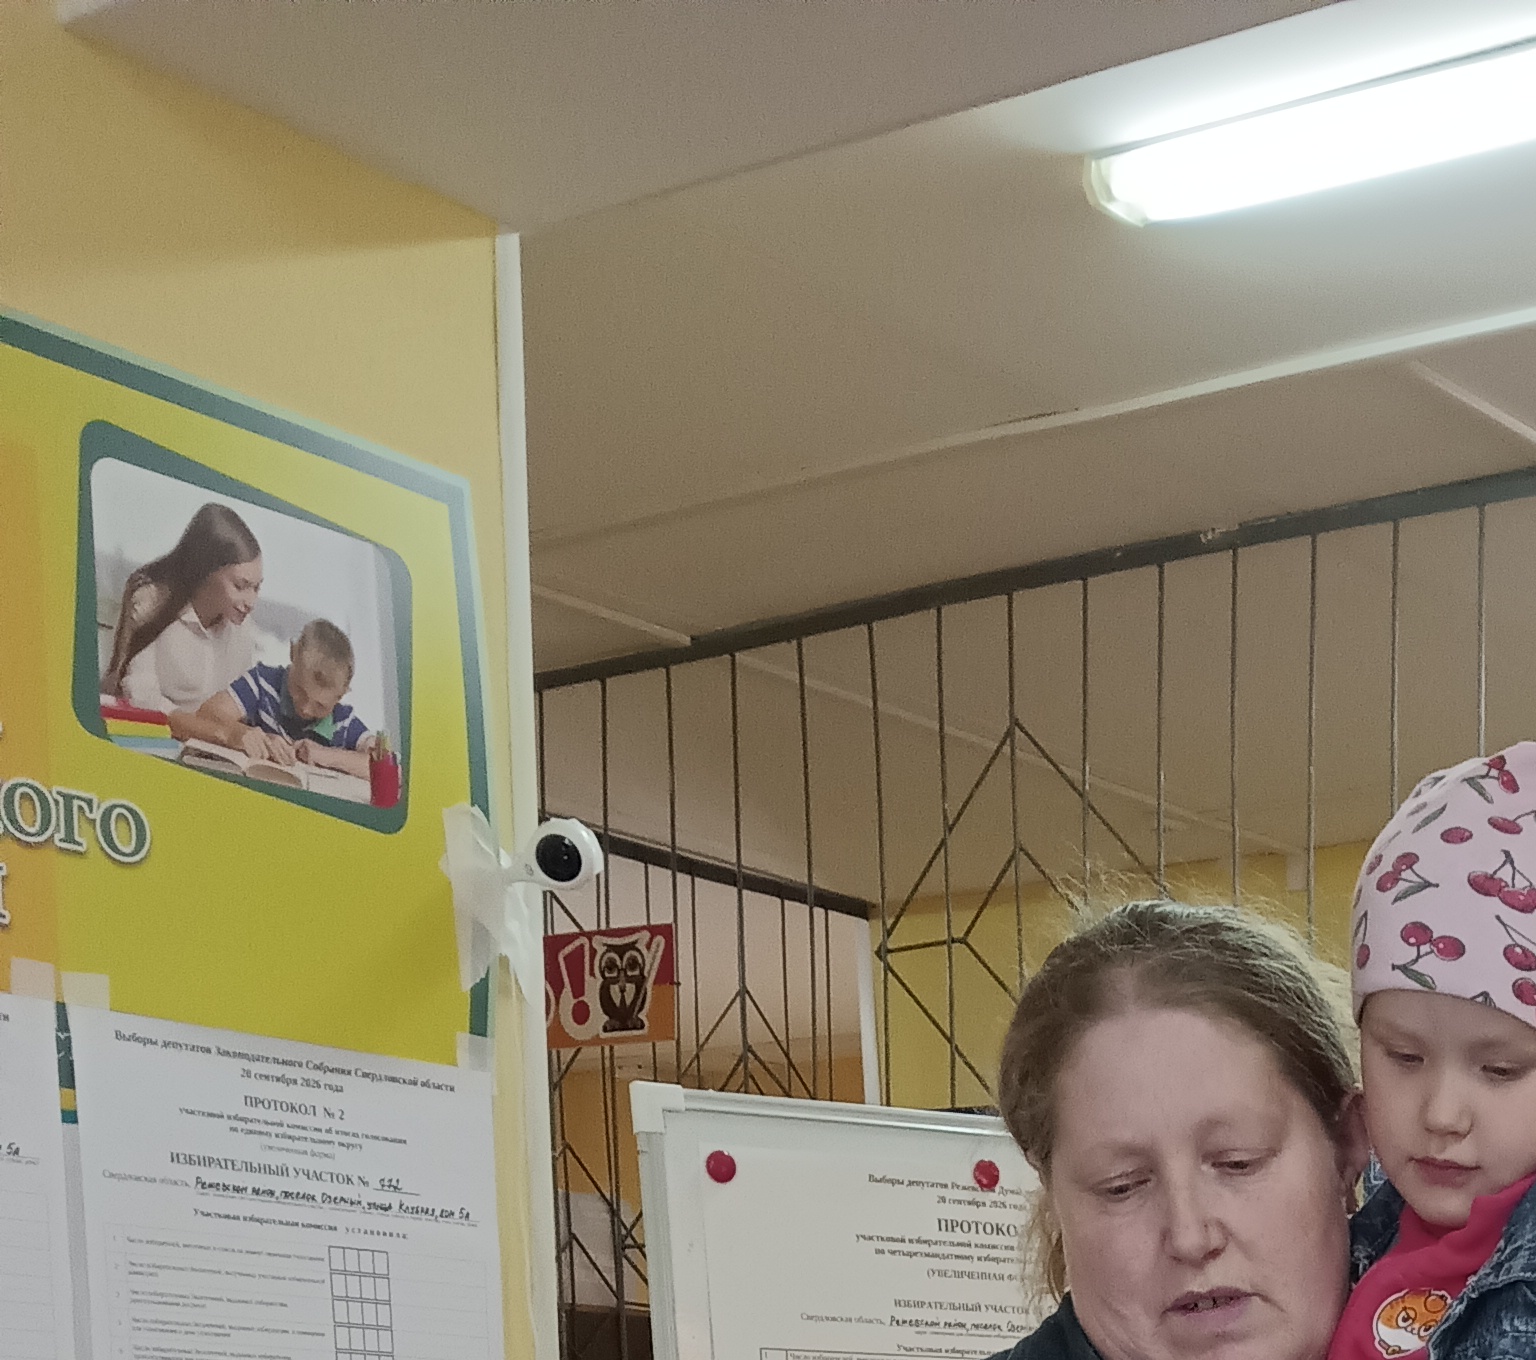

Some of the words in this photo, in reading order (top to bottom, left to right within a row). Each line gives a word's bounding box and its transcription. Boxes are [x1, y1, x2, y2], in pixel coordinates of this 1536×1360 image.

[0, 778, 150, 864] ого
[114, 1029, 159, 1046] Выборы
[161, 1039, 212, 1055] депутатов
[215, 1045, 303, 1069] Законодательного
[305, 1060, 352, 1076] Собрания
[354, 1068, 418, 1086] Свердловской
[420, 1079, 455, 1093] области
[240, 1068, 251, 1079] 20
[254, 1071, 298, 1087] сентября
[300, 1077, 321, 1090] 2026
[324, 1083, 344, 1094] года
[243, 1095, 317, 1117] ПРОТОКОЛ
[323, 1107, 335, 1119] №
[338, 1109, 345, 1121] 2
[169, 1151, 289, 1178] ИЗБИРАТЕЛЬНЫЙ
[293, 1166, 355, 1186] УЧАСТОК
[357, 1175, 370, 1188] №
[868, 1173, 904, 1187] Выборы
[906, 1179, 949, 1190] депутатов
[936, 1195, 946, 1204] 20
[948, 1198, 987, 1209] сентября
[988, 1200, 1007, 1209] 2026
[937, 1217, 1027, 1238] ПРОТОКО
[855, 1233, 906, 1244] участковой
[907, 1236, 972, 1249] избирательной
[887, 1248, 974, 1263] четырехмандатному
[926, 1268, 1004, 1282] (УВЕЛИЧЕННАЯ
[893, 1298, 982, 1312] ИЗБИРАТЕЛЬНЫЙ
